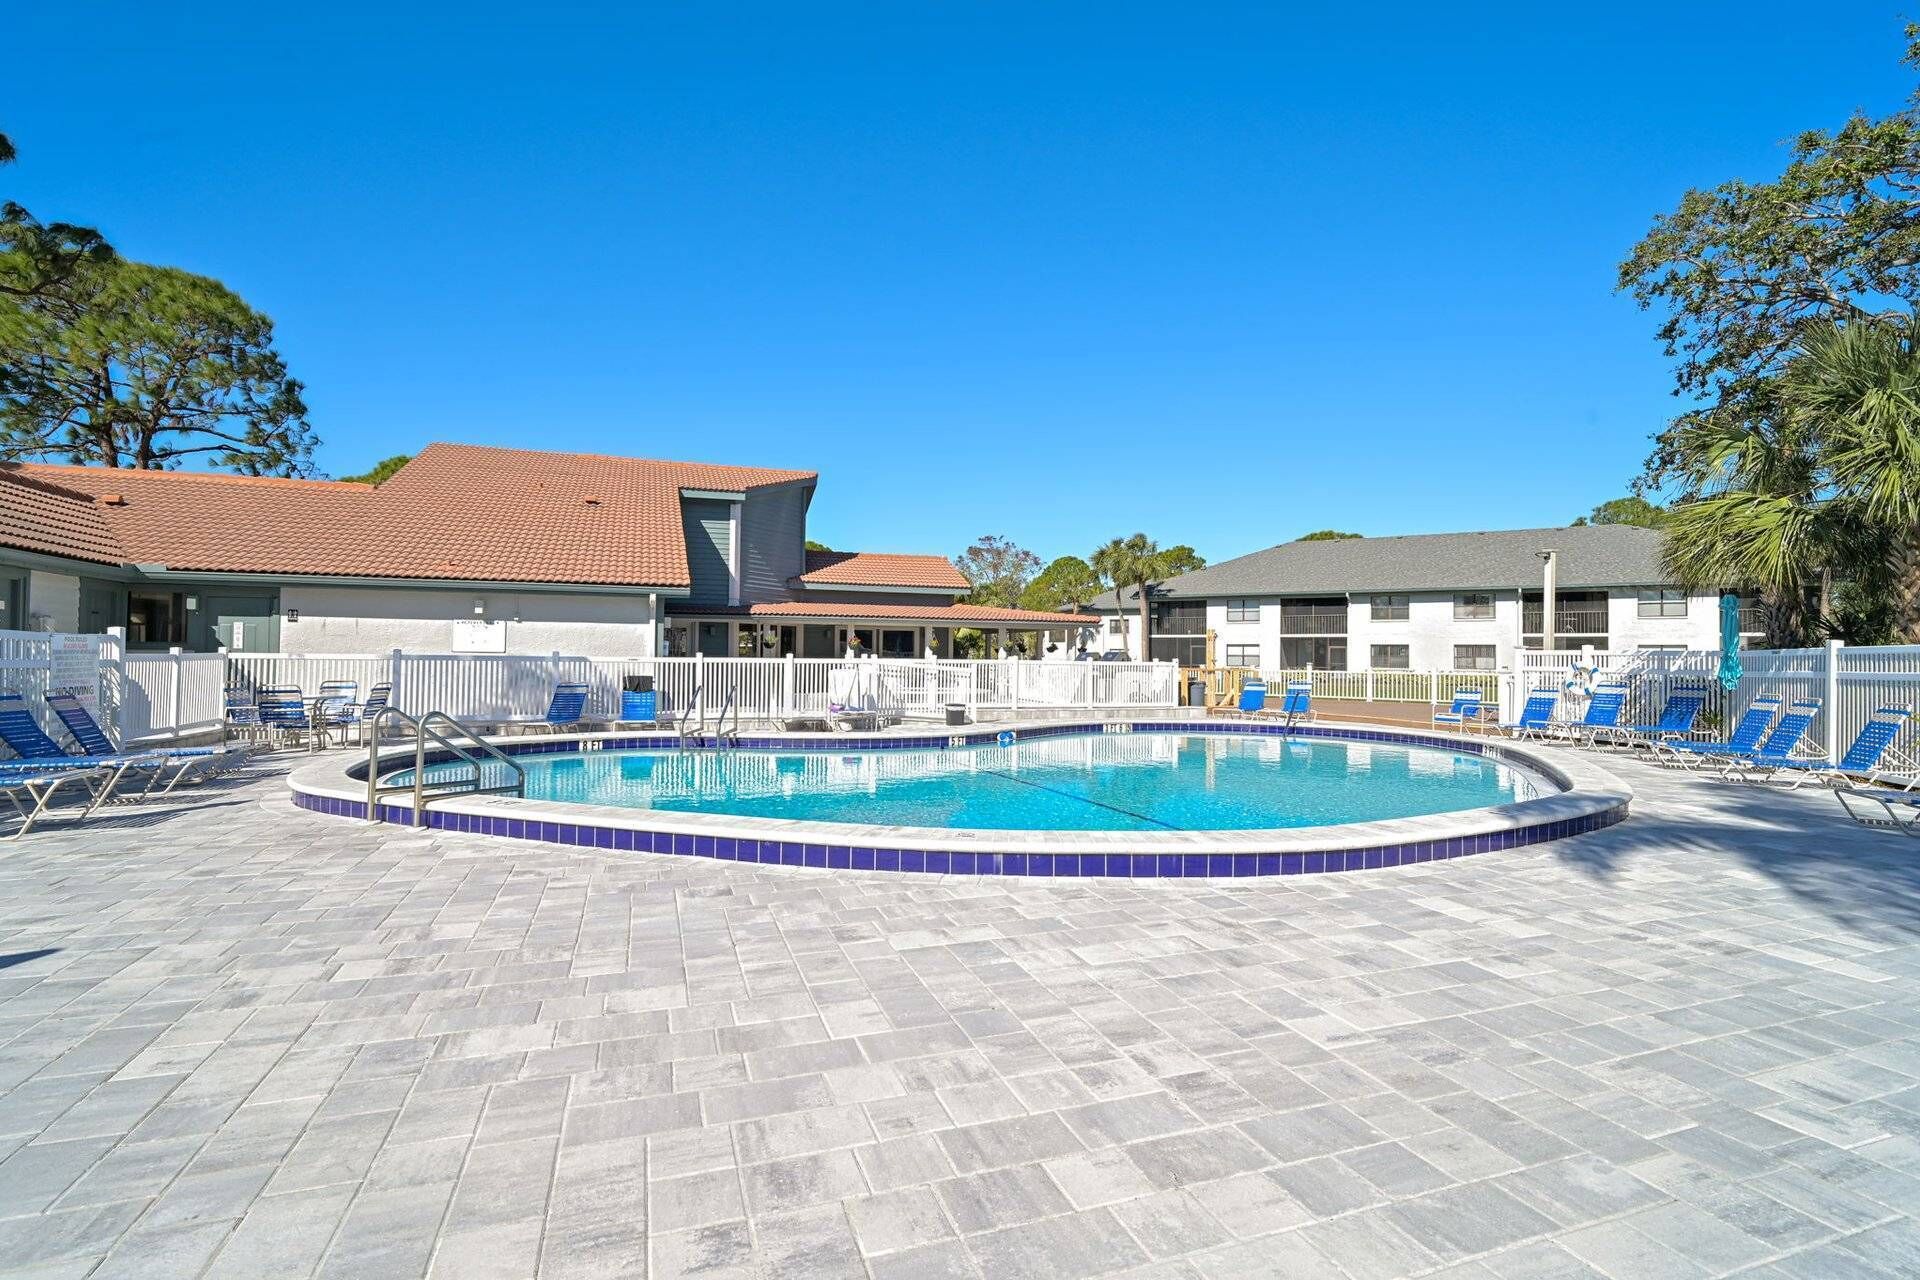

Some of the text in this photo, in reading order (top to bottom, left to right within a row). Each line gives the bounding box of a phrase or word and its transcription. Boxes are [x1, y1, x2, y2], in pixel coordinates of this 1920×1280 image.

[69, 685, 95, 696] DIVING
[582, 740, 602, 752] 8 FT
